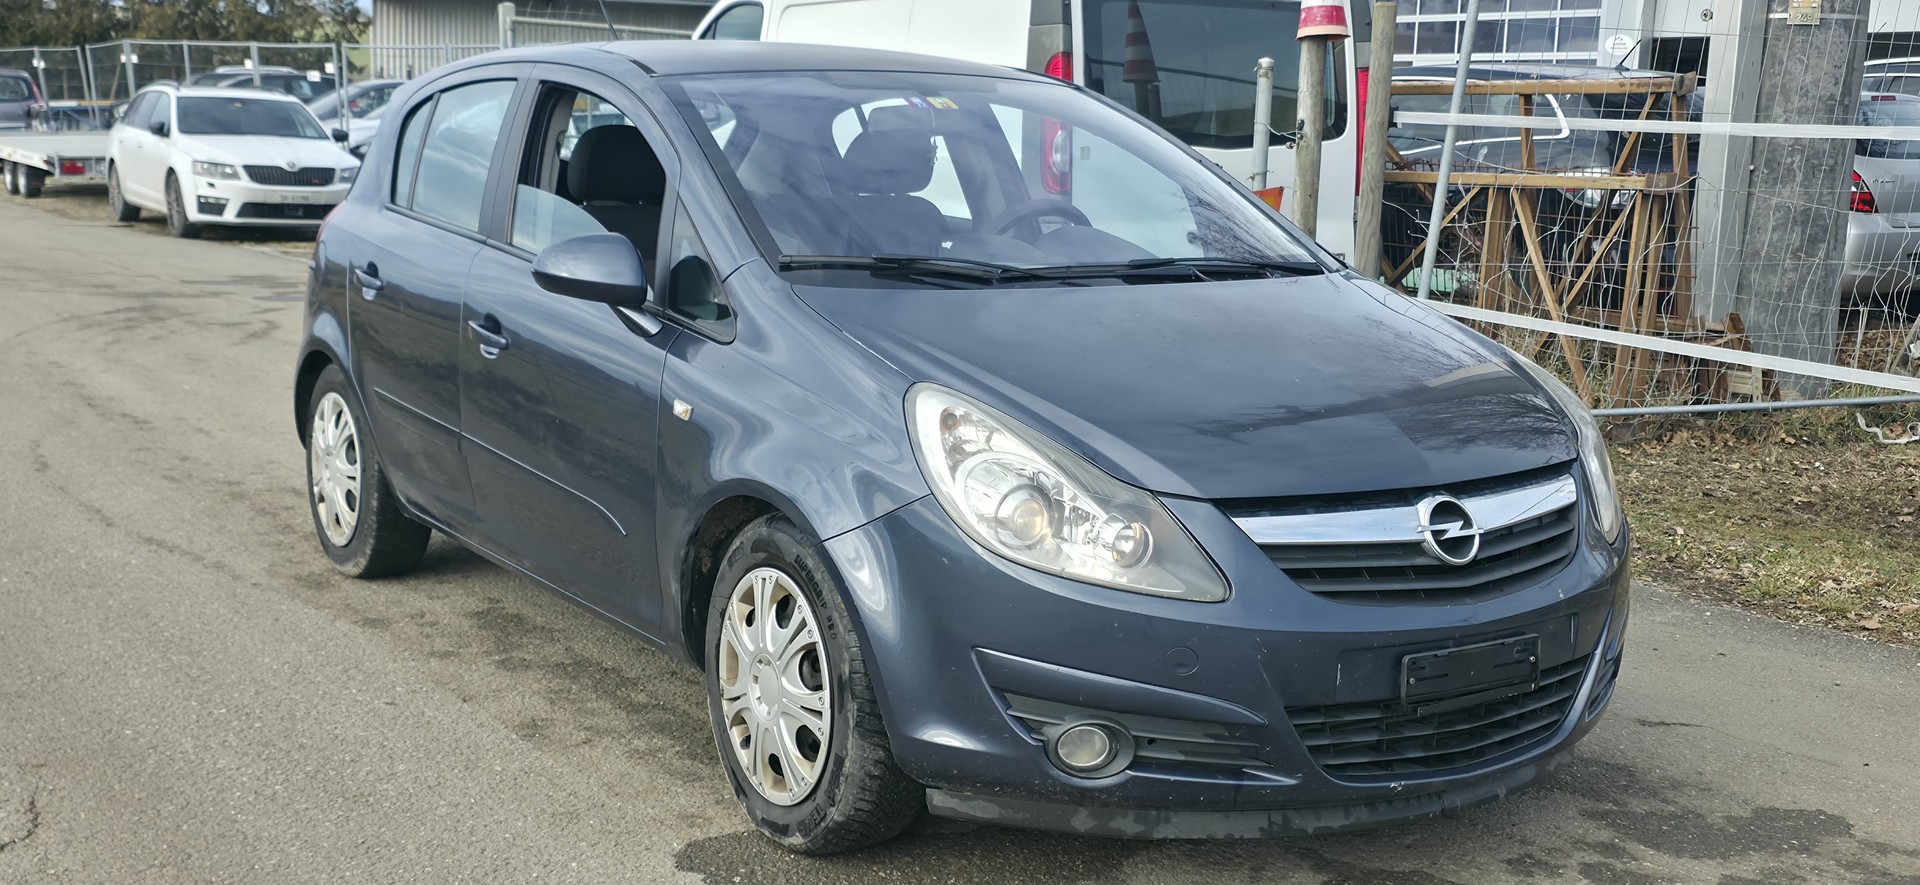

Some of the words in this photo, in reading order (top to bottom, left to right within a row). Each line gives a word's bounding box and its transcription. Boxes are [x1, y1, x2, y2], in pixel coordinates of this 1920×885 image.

[1796, 12, 1813, 23] 249
[793, 554, 828, 609] SUPERGRIP
[825, 615, 837, 641] PRO
